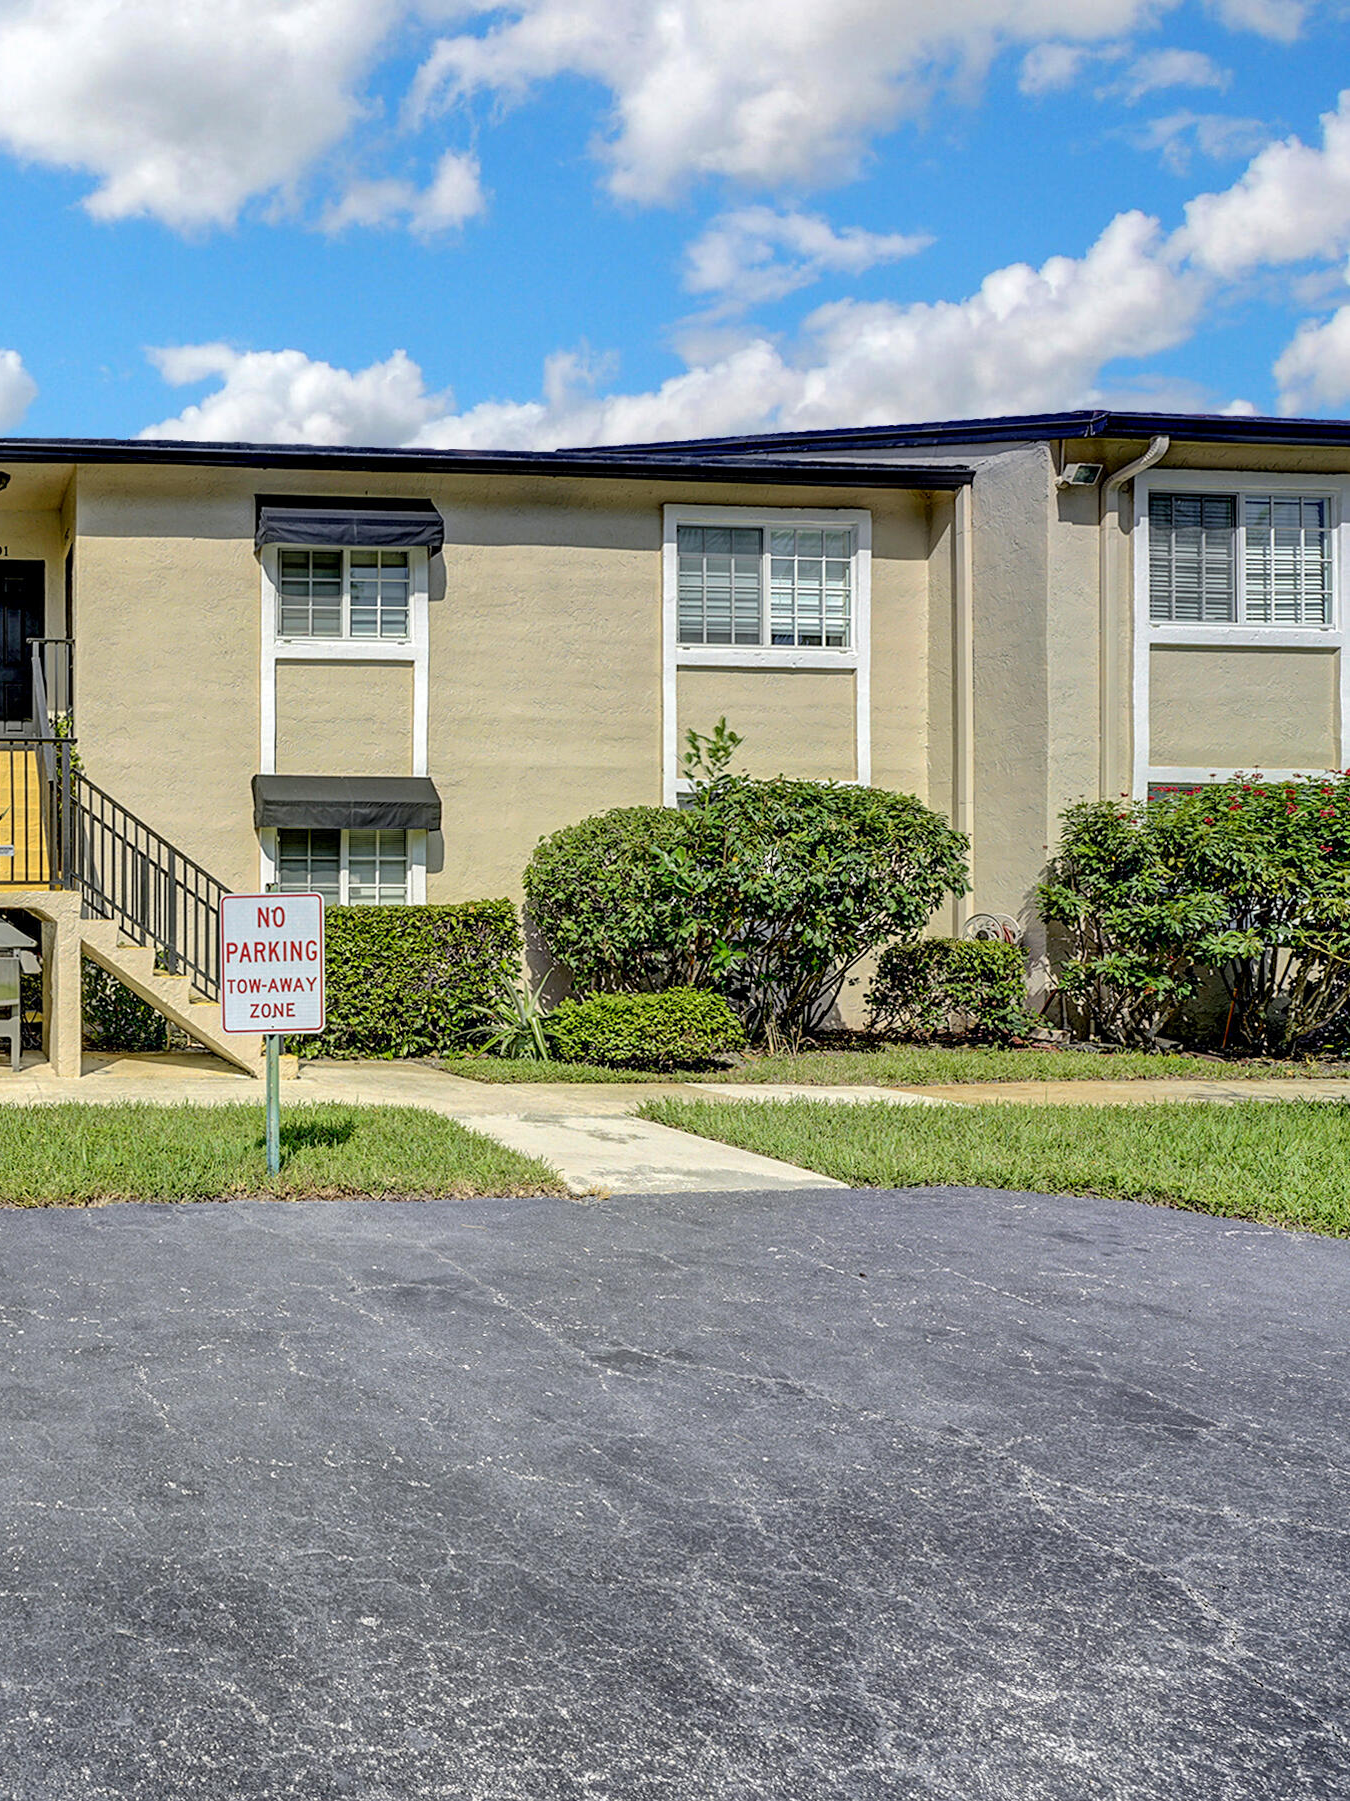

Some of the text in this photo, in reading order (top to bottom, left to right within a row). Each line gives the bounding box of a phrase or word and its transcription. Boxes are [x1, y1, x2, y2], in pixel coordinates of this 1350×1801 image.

[257, 906, 286, 928] NO
[226, 940, 318, 963] PARKING
[227, 976, 318, 994] TOW-AWAY
[250, 1002, 296, 1018] ZONE
